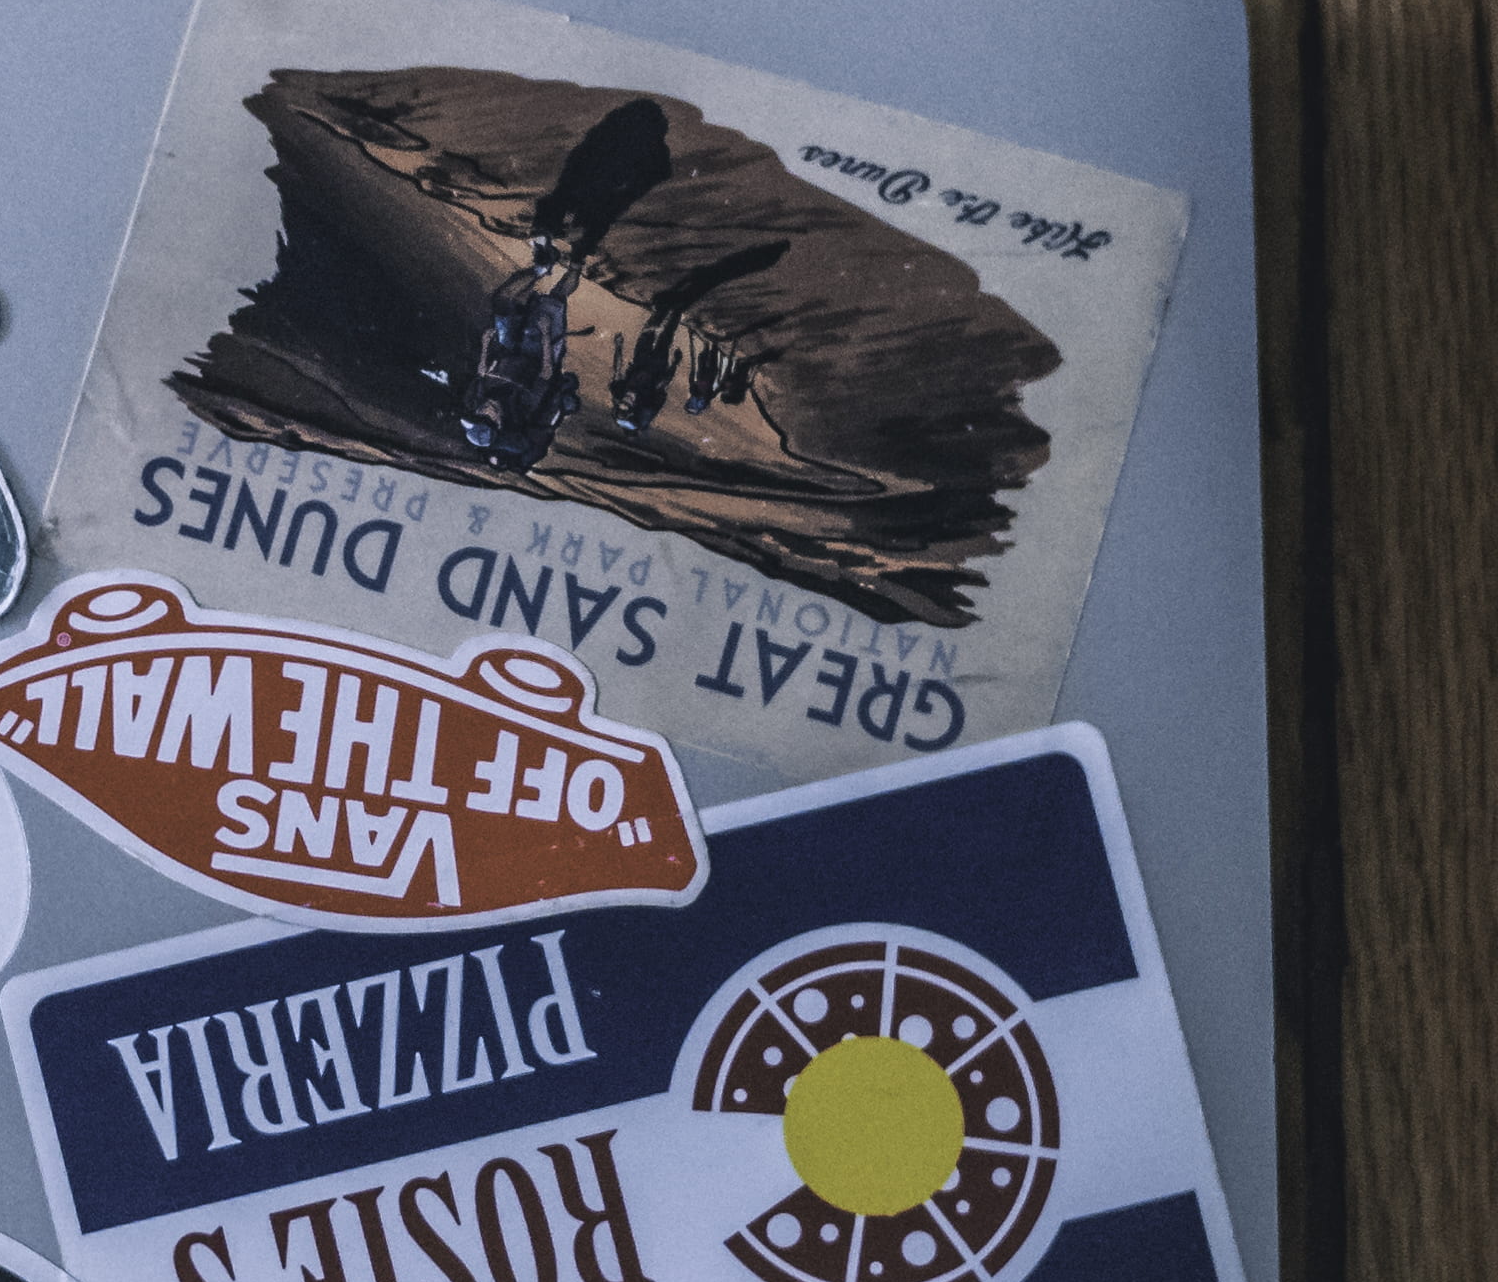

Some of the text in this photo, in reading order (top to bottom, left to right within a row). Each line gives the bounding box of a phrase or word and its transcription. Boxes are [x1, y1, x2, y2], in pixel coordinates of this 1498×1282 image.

[799, 145, 1113, 261] Hike the Dunes
[134, 456, 965, 753] GREAT SAND DUNES
[176, 420, 958, 676] NATIONAL PARK & PRESERVE
[278, 662, 448, 805] THE
[211, 778, 461, 907] VANS
[107, 929, 599, 1162] PIZZERIA
